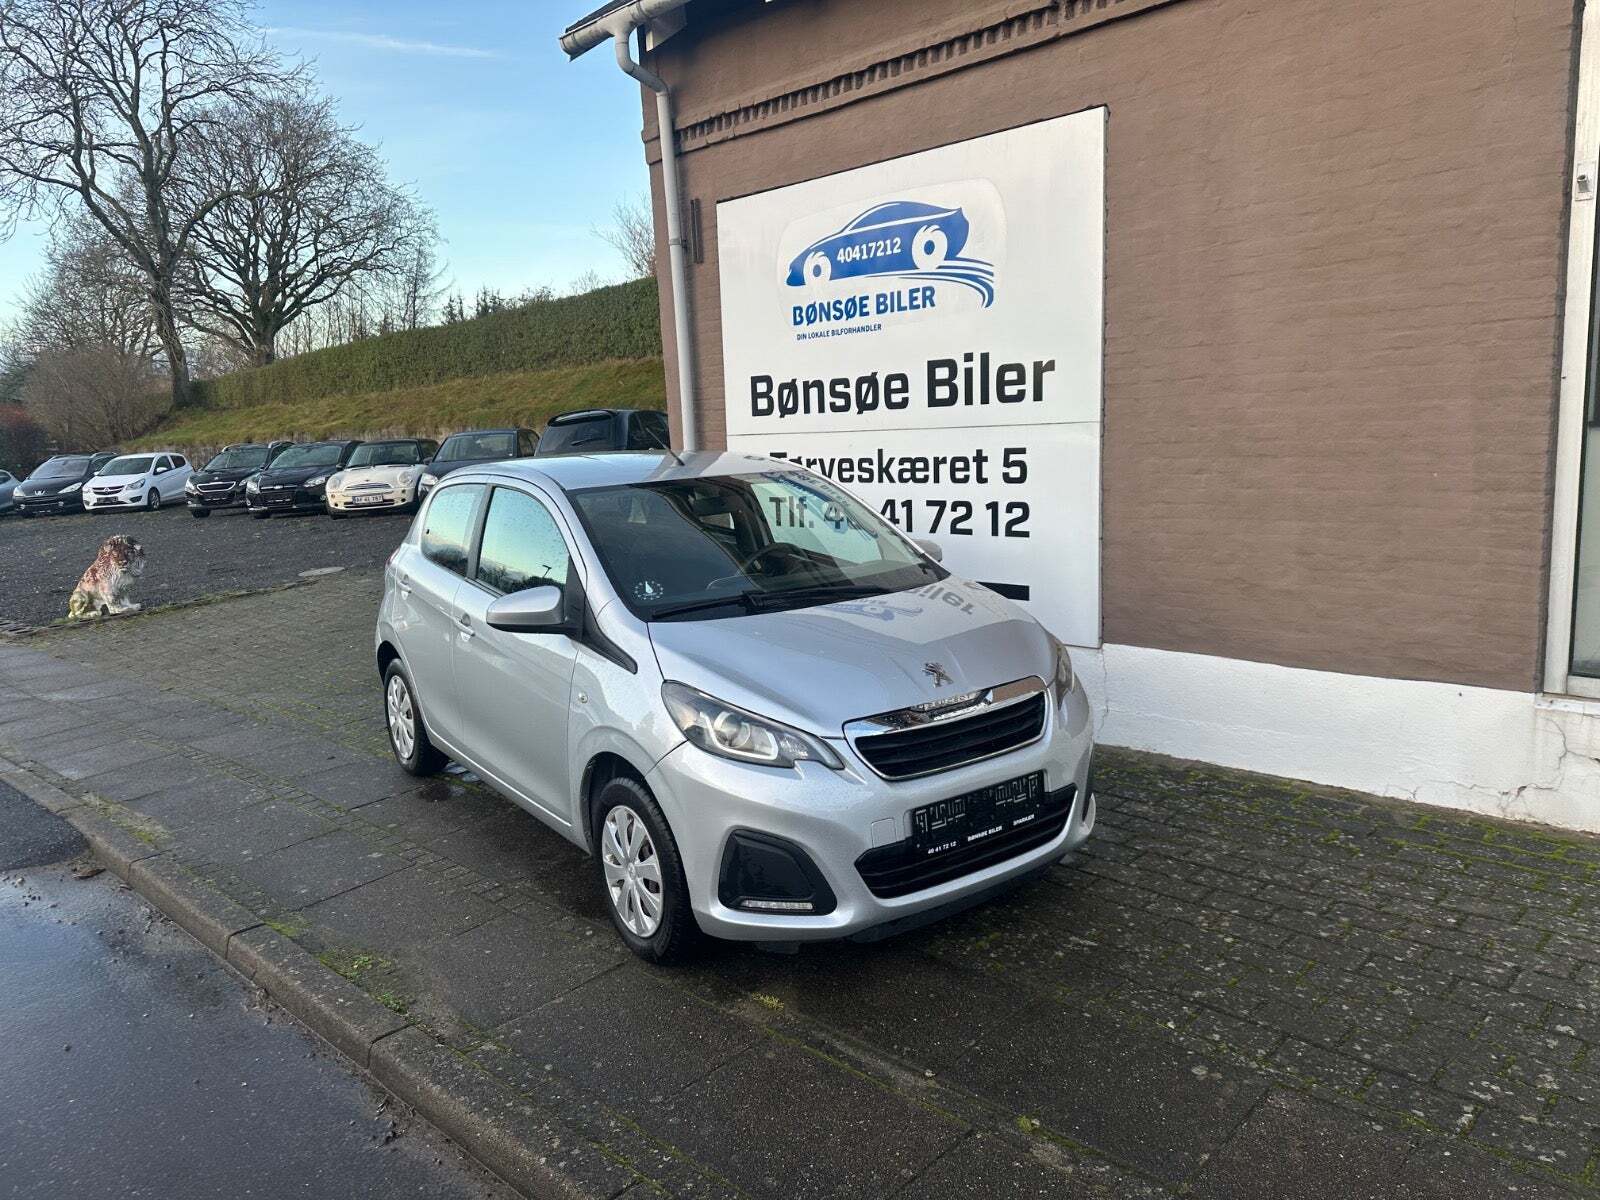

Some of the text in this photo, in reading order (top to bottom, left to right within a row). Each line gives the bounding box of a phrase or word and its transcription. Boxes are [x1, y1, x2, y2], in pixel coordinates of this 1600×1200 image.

[837, 238, 901, 264] 40417212
[793, 286, 936, 326] BØNSØE BILER
[796, 323, 882, 341] DIN LOKALE BILFORHANDLER
[750, 352, 1056, 418] Bønsøe Biler
[770, 448, 1028, 484] rveskæret 5
[880, 499, 913, 532] 41
[926, 500, 973, 536] 72
[985, 501, 1030, 538] 12
